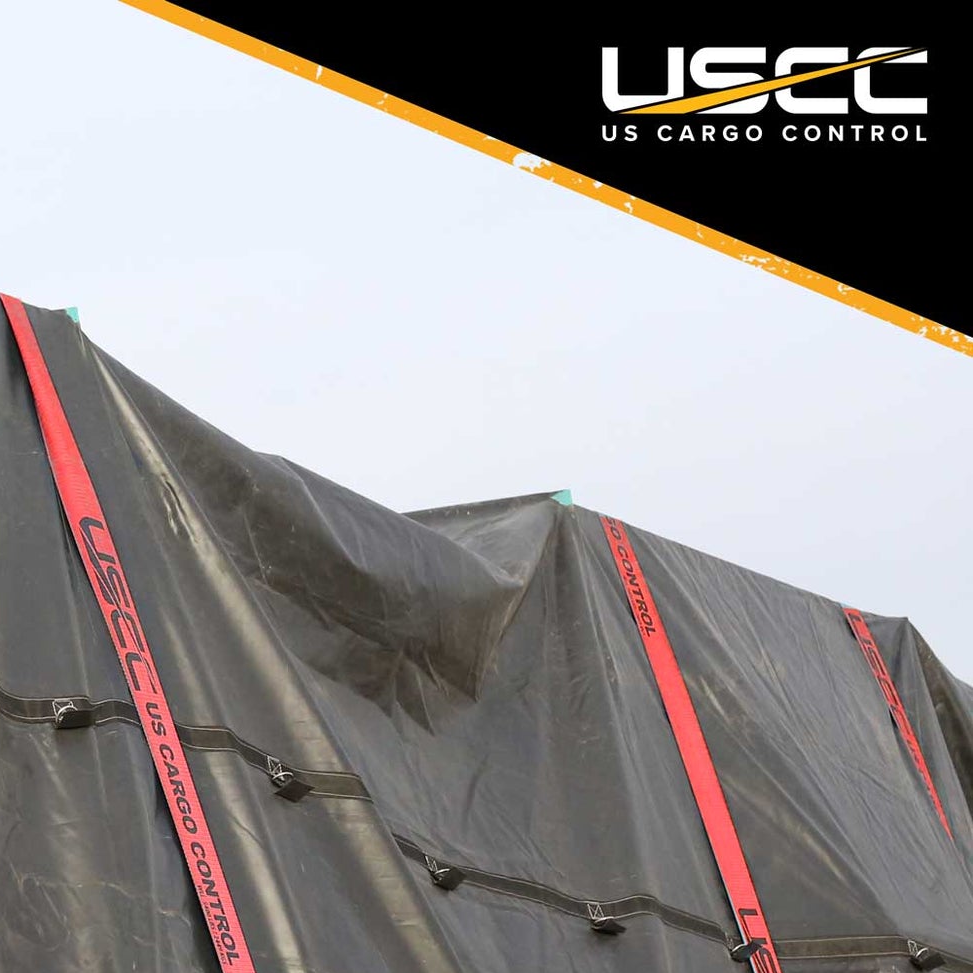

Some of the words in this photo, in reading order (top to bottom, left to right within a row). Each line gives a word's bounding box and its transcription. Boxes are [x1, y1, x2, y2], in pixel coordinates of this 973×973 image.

[617, 545, 656, 637] CONTROL
[78, 516, 158, 694] USCC
[145, 702, 167, 738] US
[159, 744, 198, 835] CARGO
[190, 841, 240, 966] CONTROL
